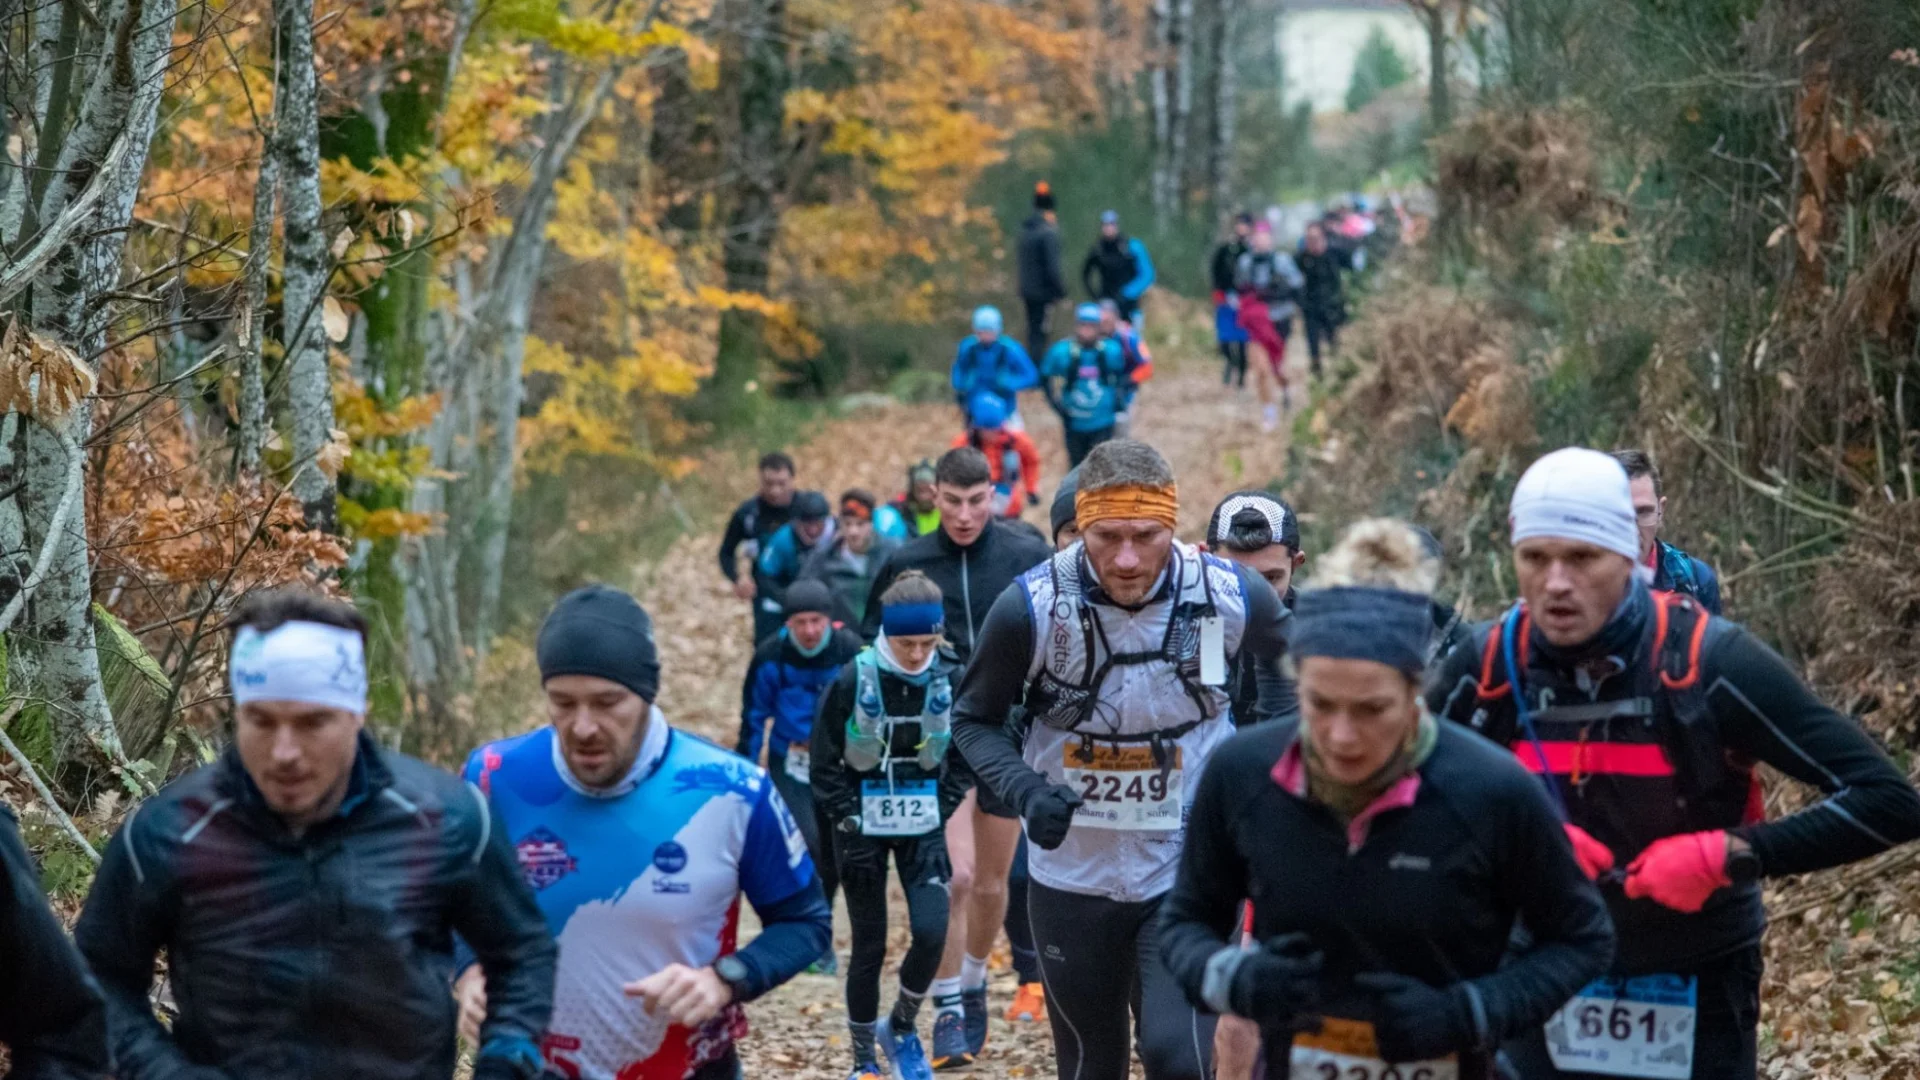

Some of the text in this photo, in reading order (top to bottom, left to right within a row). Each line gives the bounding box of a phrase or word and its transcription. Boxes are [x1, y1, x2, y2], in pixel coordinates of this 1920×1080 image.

[1081, 774, 1168, 803] 2249
[881, 798, 923, 817] 812
[1579, 1004, 1657, 1044] 661
